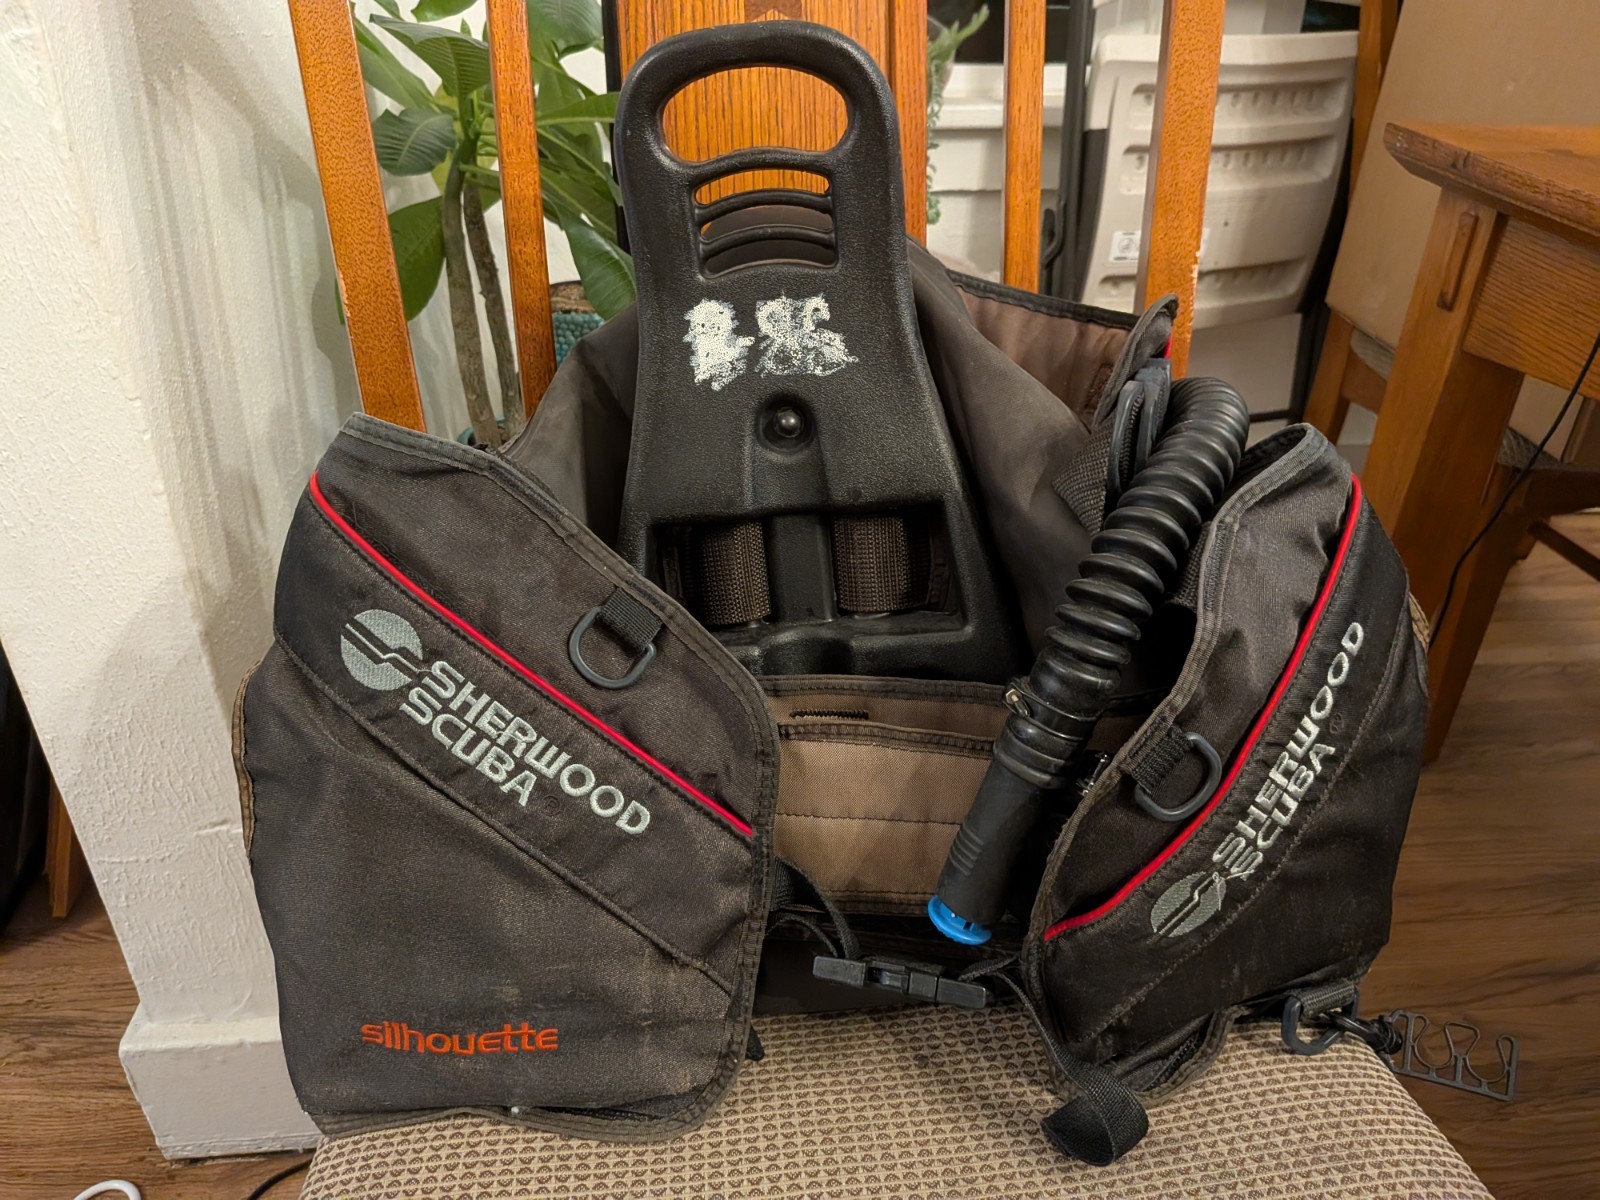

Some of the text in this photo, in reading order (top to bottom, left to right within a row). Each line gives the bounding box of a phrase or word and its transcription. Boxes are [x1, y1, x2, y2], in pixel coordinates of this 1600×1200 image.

[400, 687, 537, 806] SCUBA
[422, 661, 650, 834] SHERWOOD
[1213, 622, 1363, 867] SHERWOOD
[1230, 743, 1335, 880] SCUBA
[361, 1021, 558, 1055] silhouette
